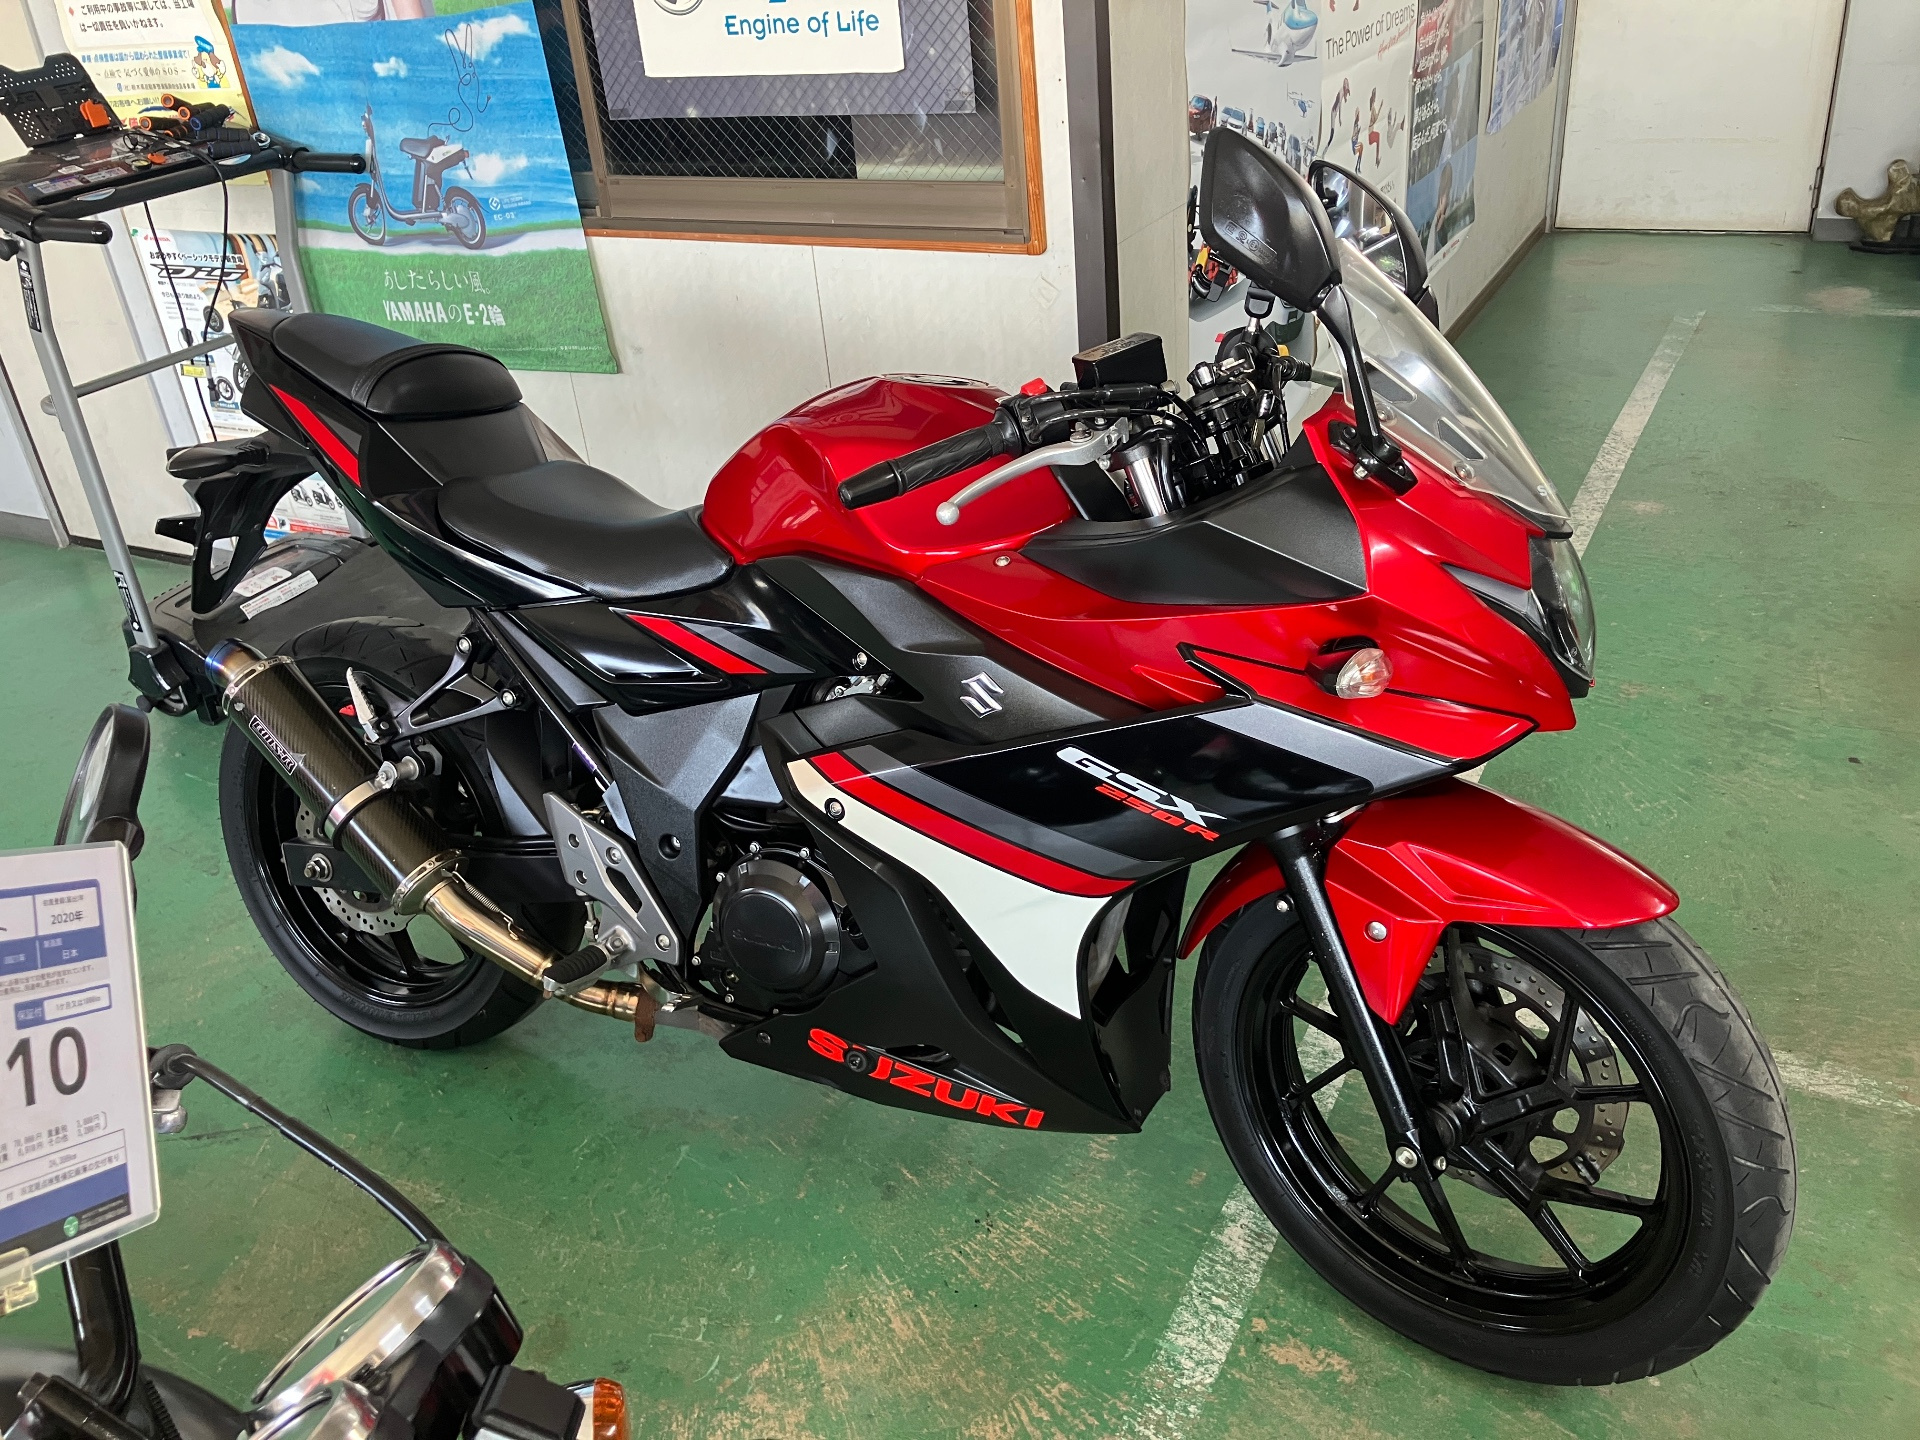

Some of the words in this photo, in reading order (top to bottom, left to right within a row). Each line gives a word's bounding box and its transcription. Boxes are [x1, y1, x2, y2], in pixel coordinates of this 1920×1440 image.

[724, 14, 800, 40] Engine
[807, 11, 829, 37] of
[836, 10, 880, 36] Life
[1325, 37, 1344, 60] The
[1345, 22, 1375, 52] Power
[1375, 13, 1385, 37] of
[1385, 3, 1416, 32] Dreams
[384, 270, 491, 294] あしたらしい風。
[1056, 746, 1227, 828] GSX
[1094, 783, 1220, 842] 250R
[51, 910, 84, 925] 2020年
[6, 1026, 88, 1107] 10
